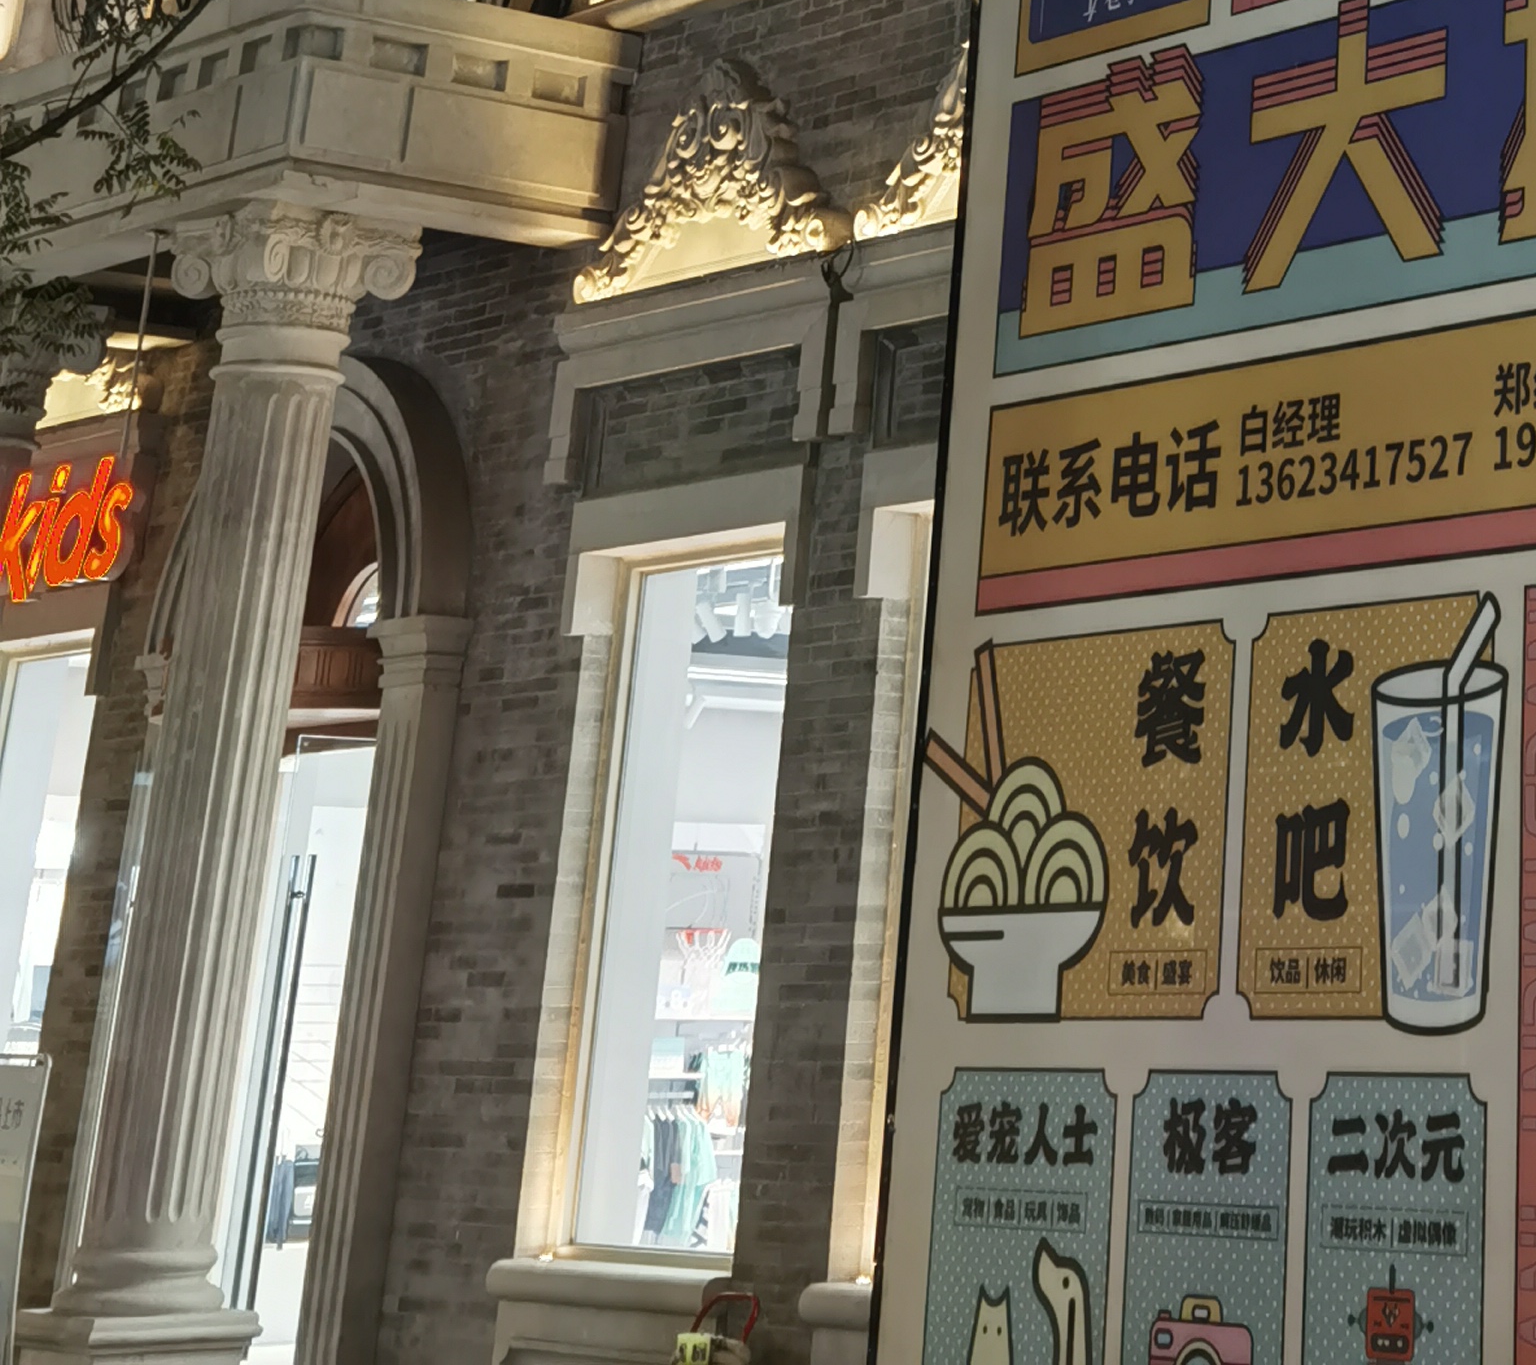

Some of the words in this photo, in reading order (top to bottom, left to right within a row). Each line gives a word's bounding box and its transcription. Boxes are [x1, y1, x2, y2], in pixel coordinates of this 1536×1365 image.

[1238, 392, 1342, 457] 白经理
[998, 418, 1223, 538] 联系电话
[1235, 432, 1474, 508] 13623417527
[0, 455, 133, 603] kids
[951, 1101, 1099, 1168] 爱宠人士
[1162, 1098, 1259, 1177] 极客
[1327, 1109, 1467, 1184] 二次元
